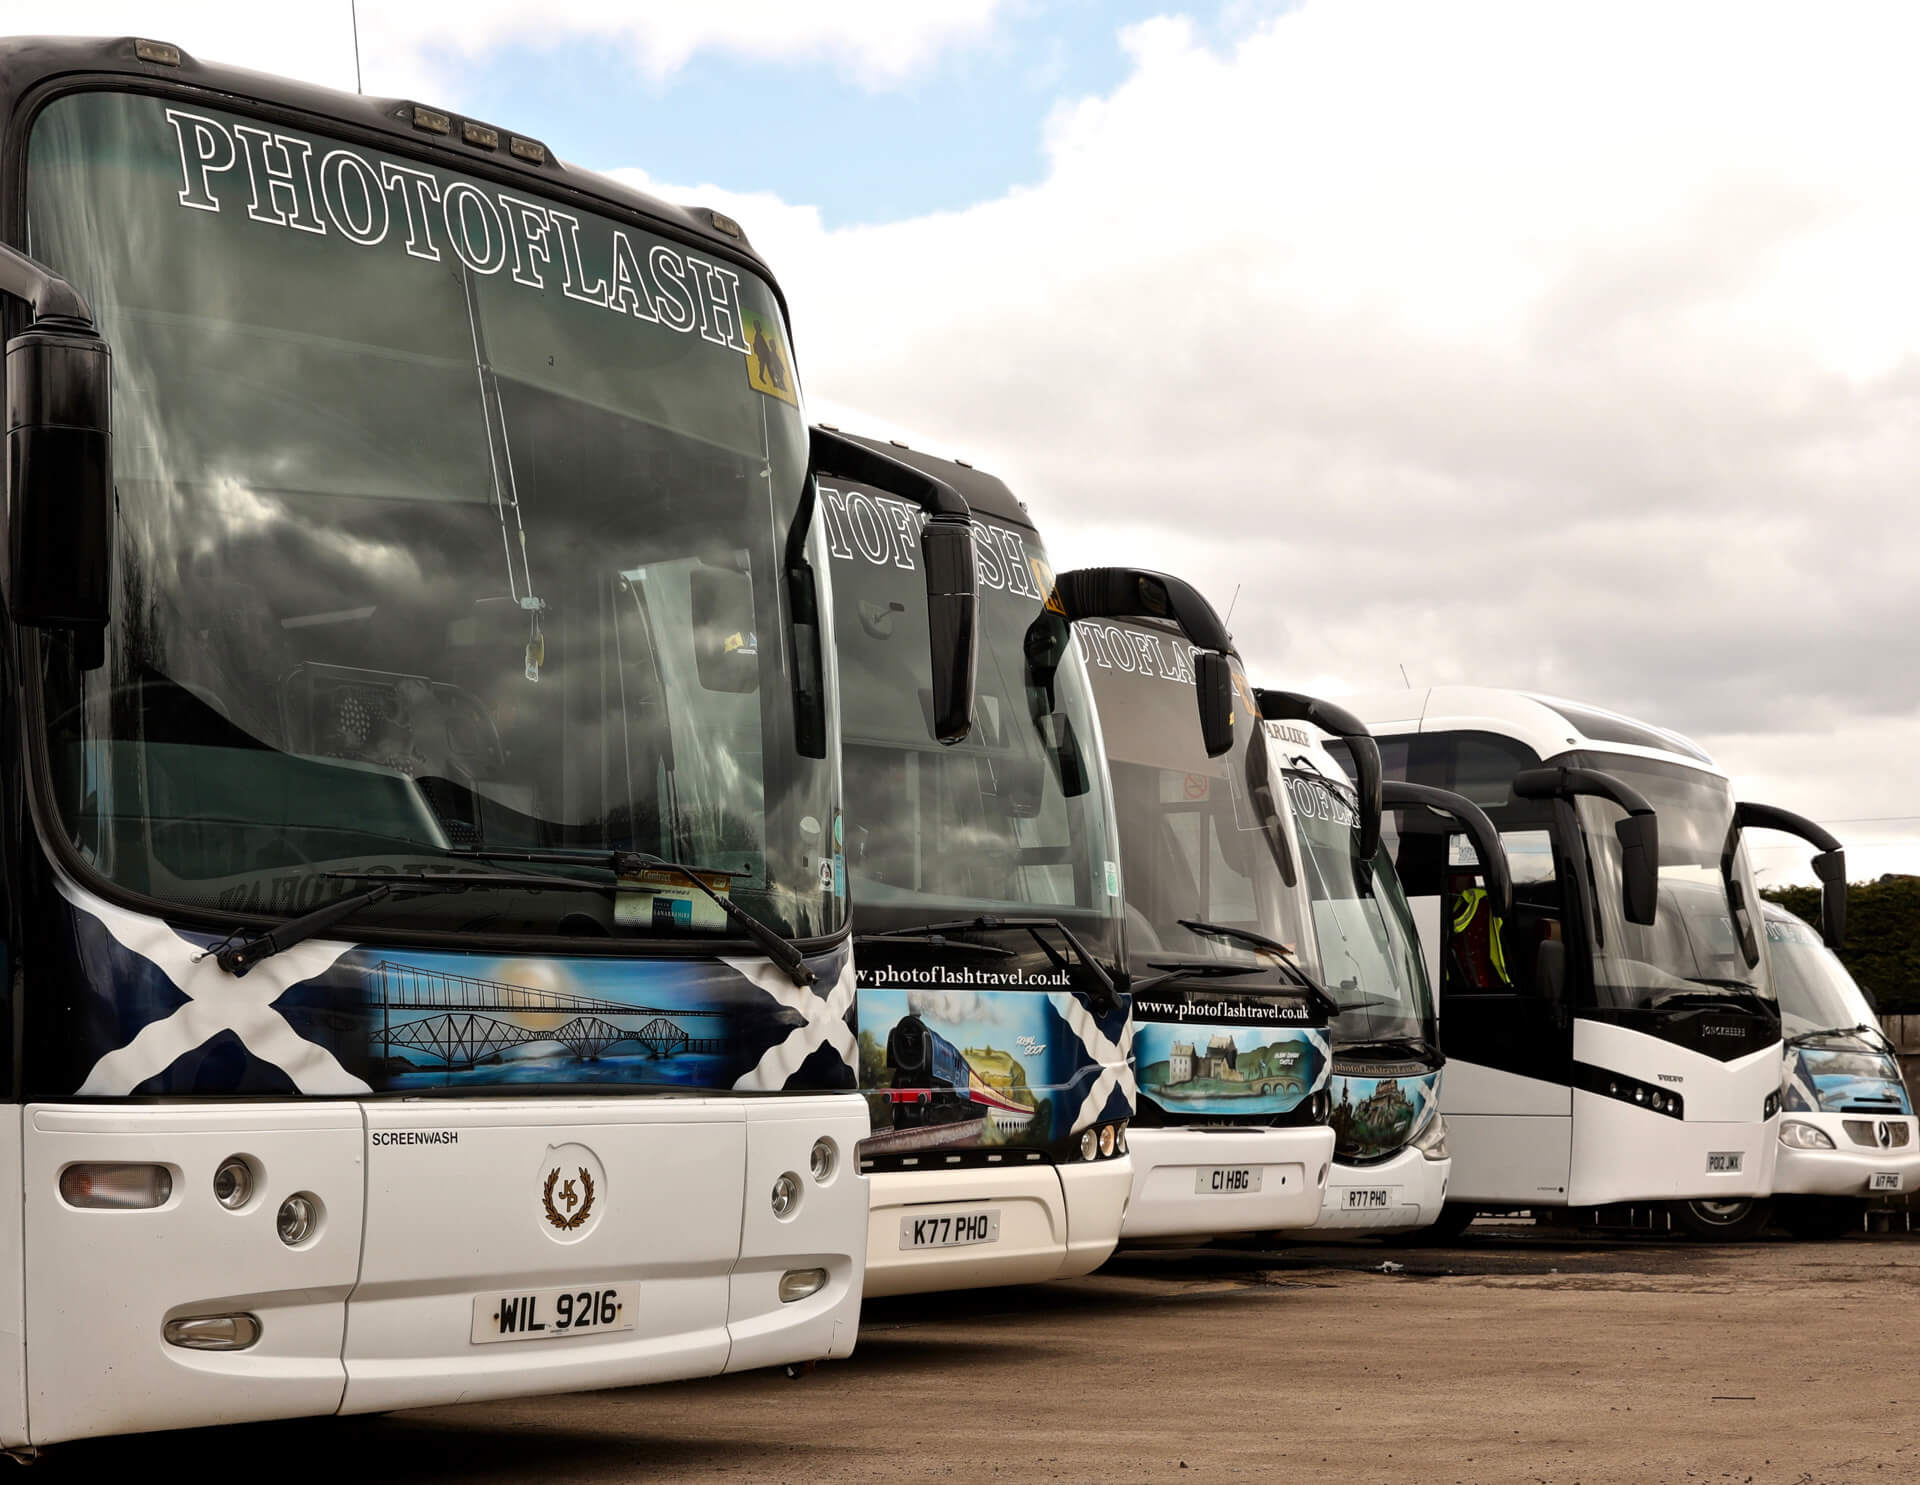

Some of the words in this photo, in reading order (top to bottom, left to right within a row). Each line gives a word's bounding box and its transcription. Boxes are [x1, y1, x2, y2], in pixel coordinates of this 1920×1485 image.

[165, 108, 753, 355] PHOTOFLASH
[818, 486, 1042, 601] TOFSH
[1137, 1000, 1309, 1020] www.photoflashtravel.co.uk
[1657, 1074, 1684, 1083] VOLVO
[372, 1131, 458, 1146] SCREENWASH
[1226, 1170, 1249, 1190] HBG
[1350, 1191, 1368, 1207] R77
[1370, 1190, 1387, 1206] PHO
[914, 1218, 951, 1245] K77
[955, 1215, 988, 1241] PHO
[500, 1296, 546, 1334] WIL
[556, 1290, 617, 1329] 9216
